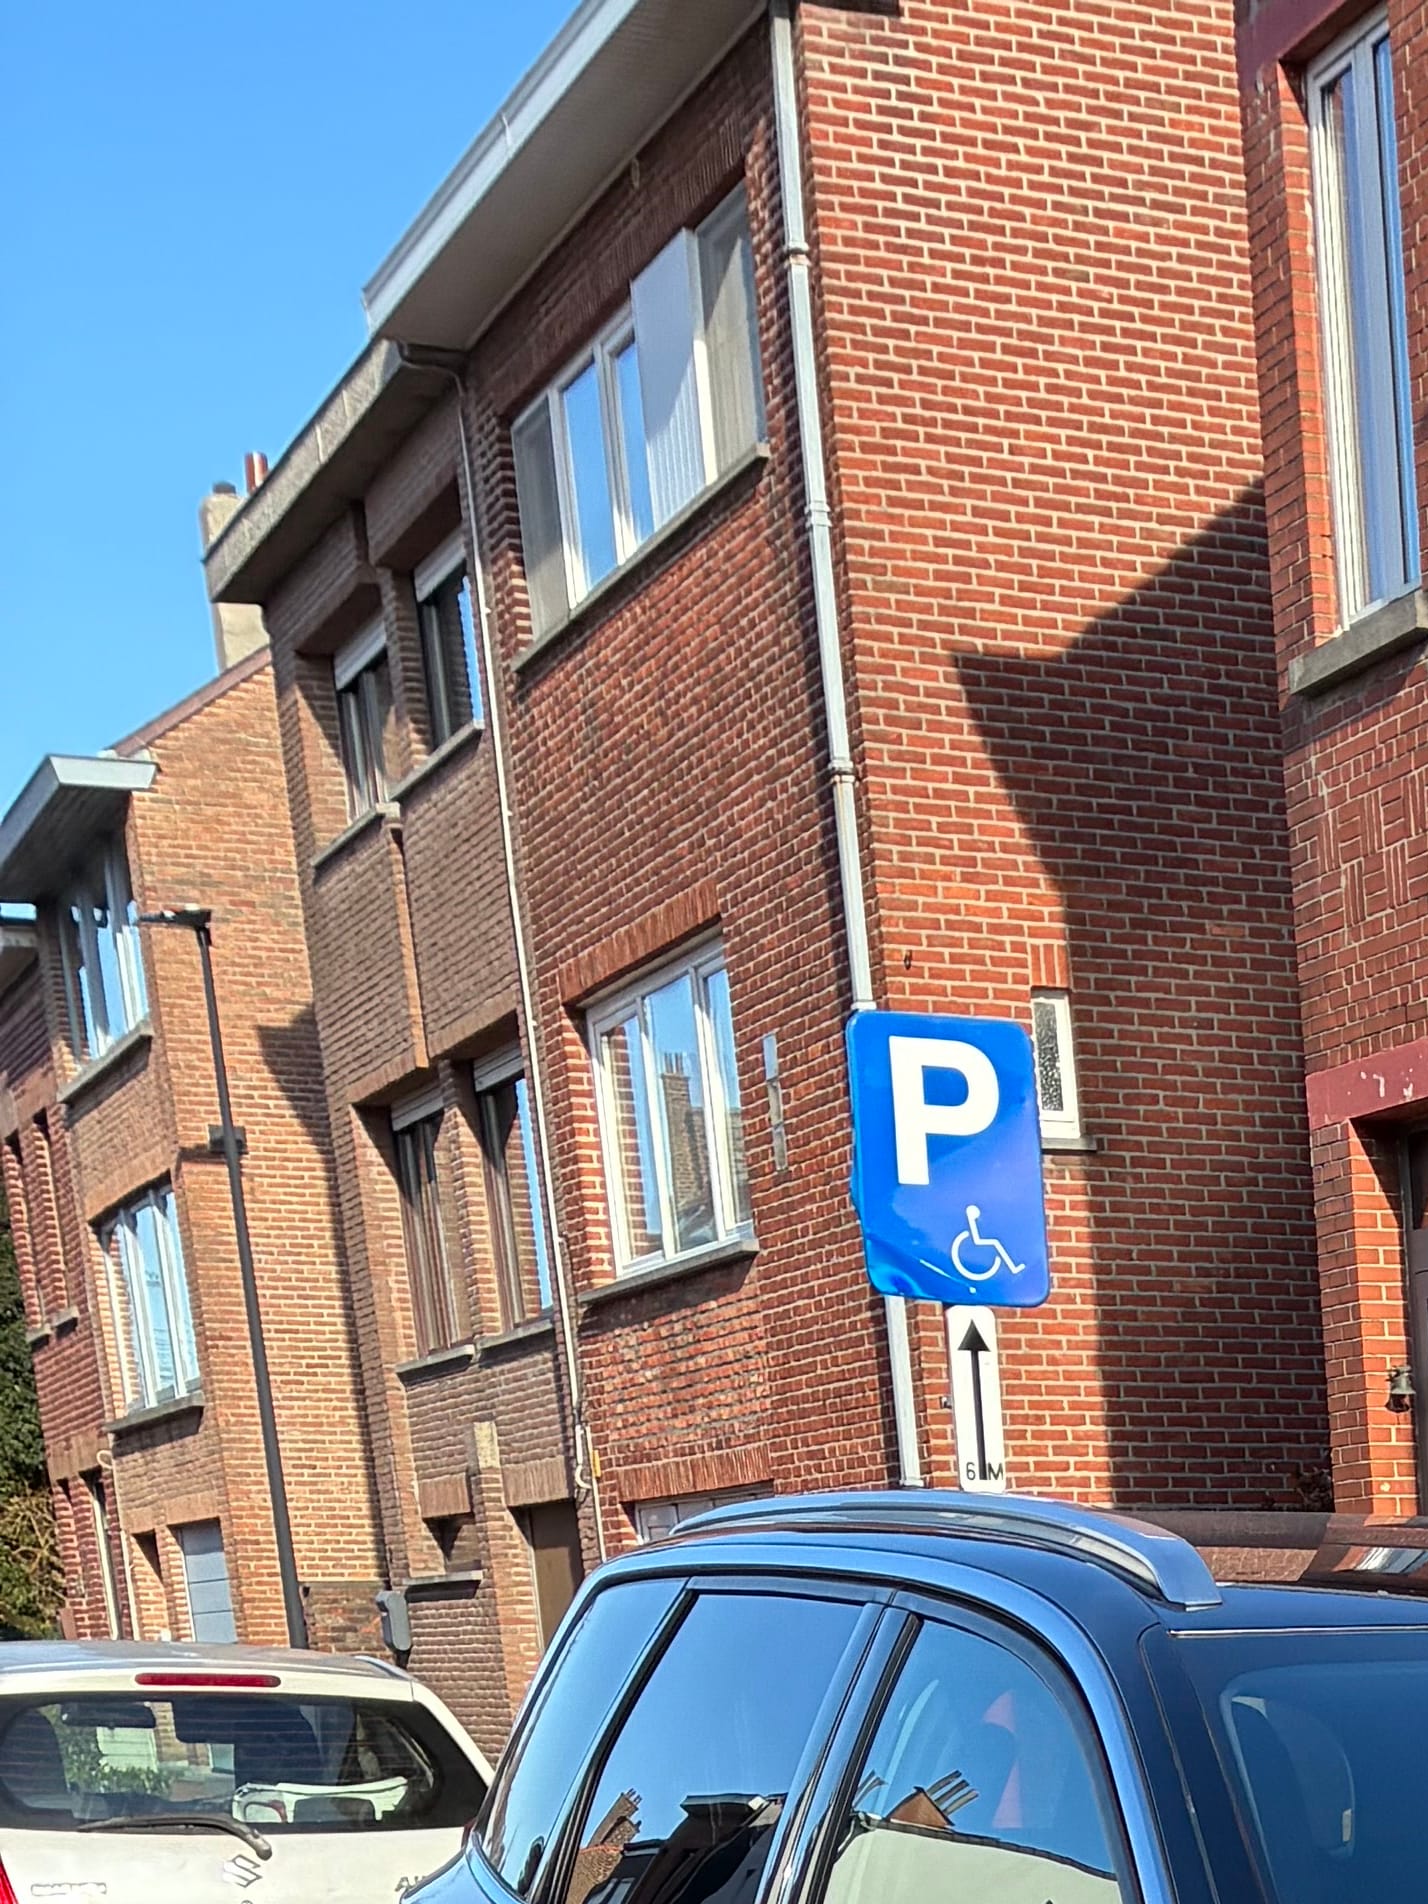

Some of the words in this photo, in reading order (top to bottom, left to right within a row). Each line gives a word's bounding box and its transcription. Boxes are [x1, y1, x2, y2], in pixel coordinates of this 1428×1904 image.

[888, 1035, 1000, 1185] P
[966, 1461, 976, 1481] 6
[987, 1461, 1004, 1481] M
